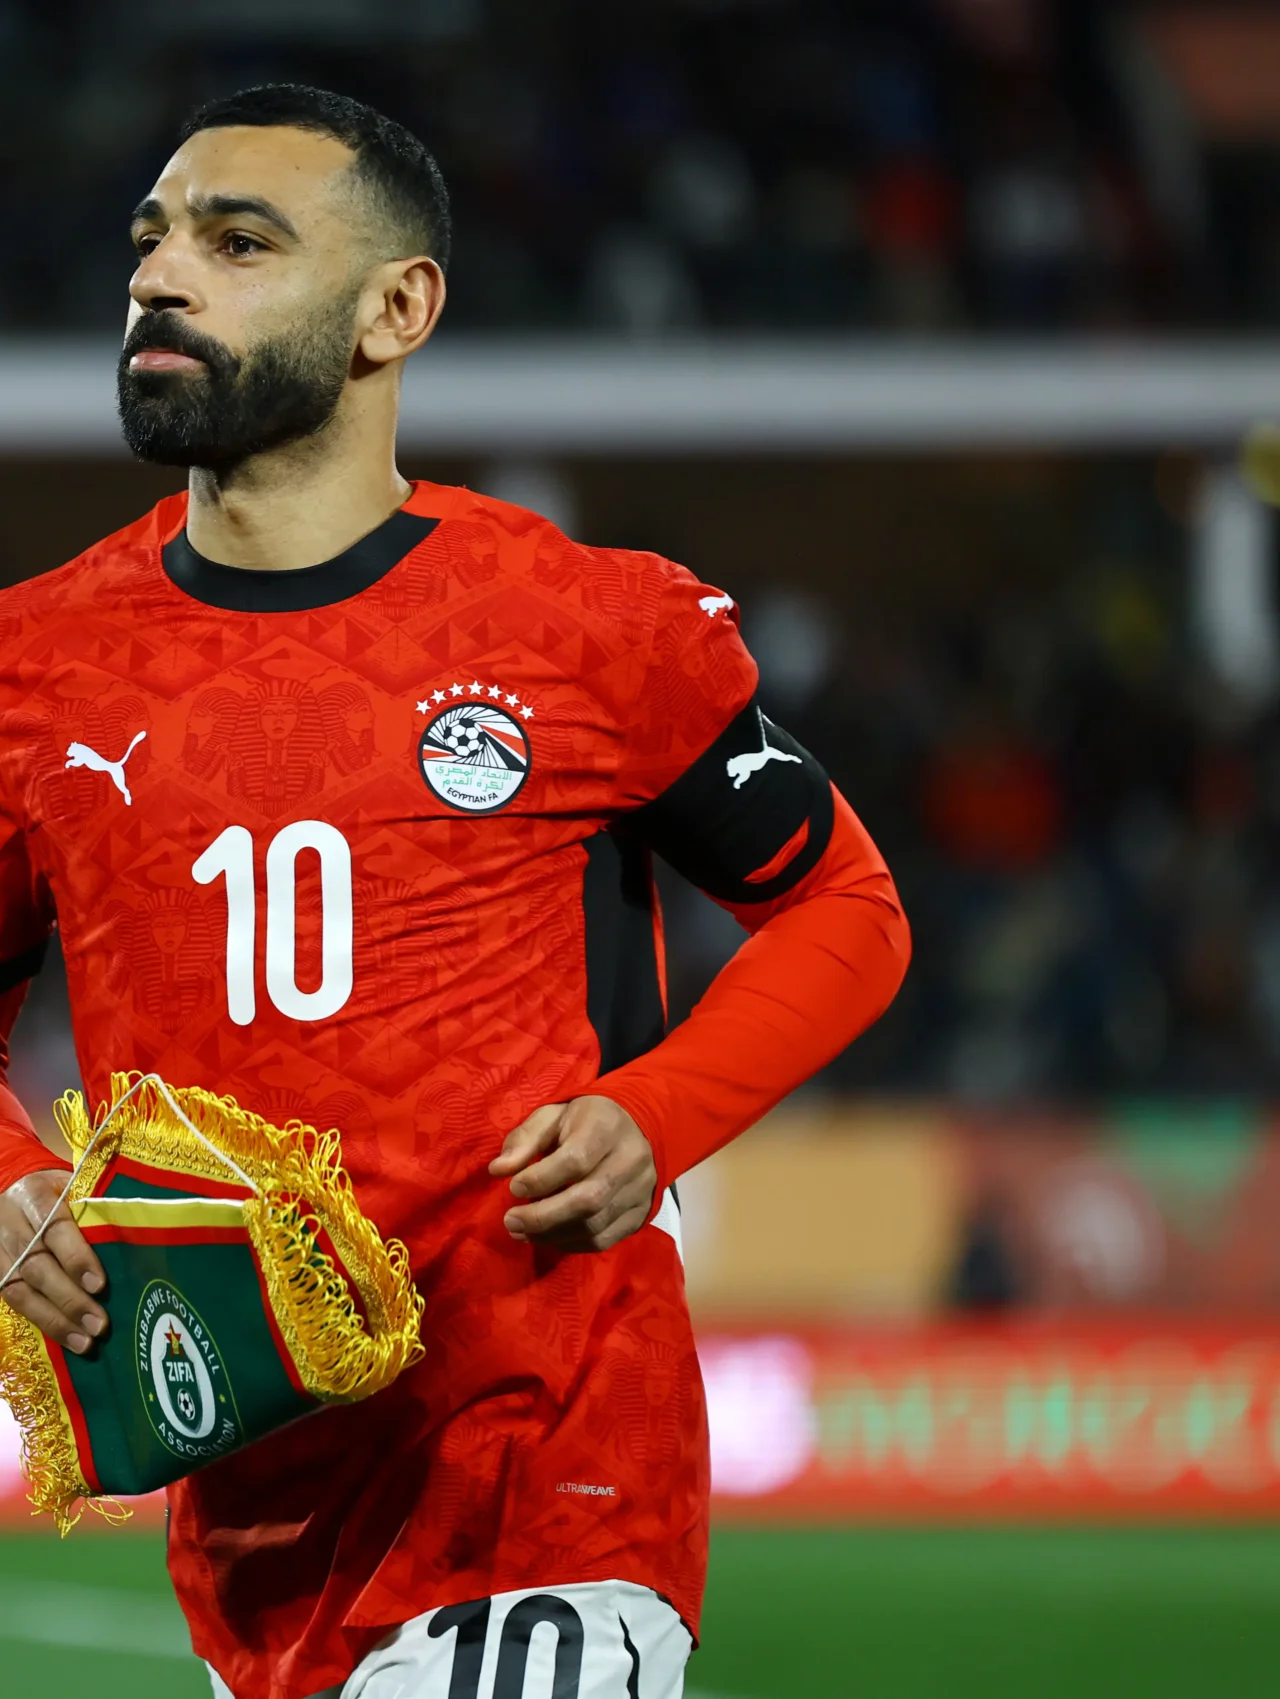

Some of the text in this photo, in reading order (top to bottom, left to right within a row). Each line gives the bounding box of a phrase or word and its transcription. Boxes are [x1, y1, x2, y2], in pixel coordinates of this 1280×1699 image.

[442, 777, 504, 792] لكرة القدم
[446, 787, 499, 803] EGYPTIAN FA
[191, 819, 353, 1026] 10
[140, 1288, 220, 1375] ZIMBABWE FOOTBALL
[166, 1361, 195, 1383] ZIFA
[158, 1417, 236, 1457] ASSOCIATION
[556, 1482, 616, 1496] ULTRAWEAVE
[427, 1594, 584, 1699] 10
